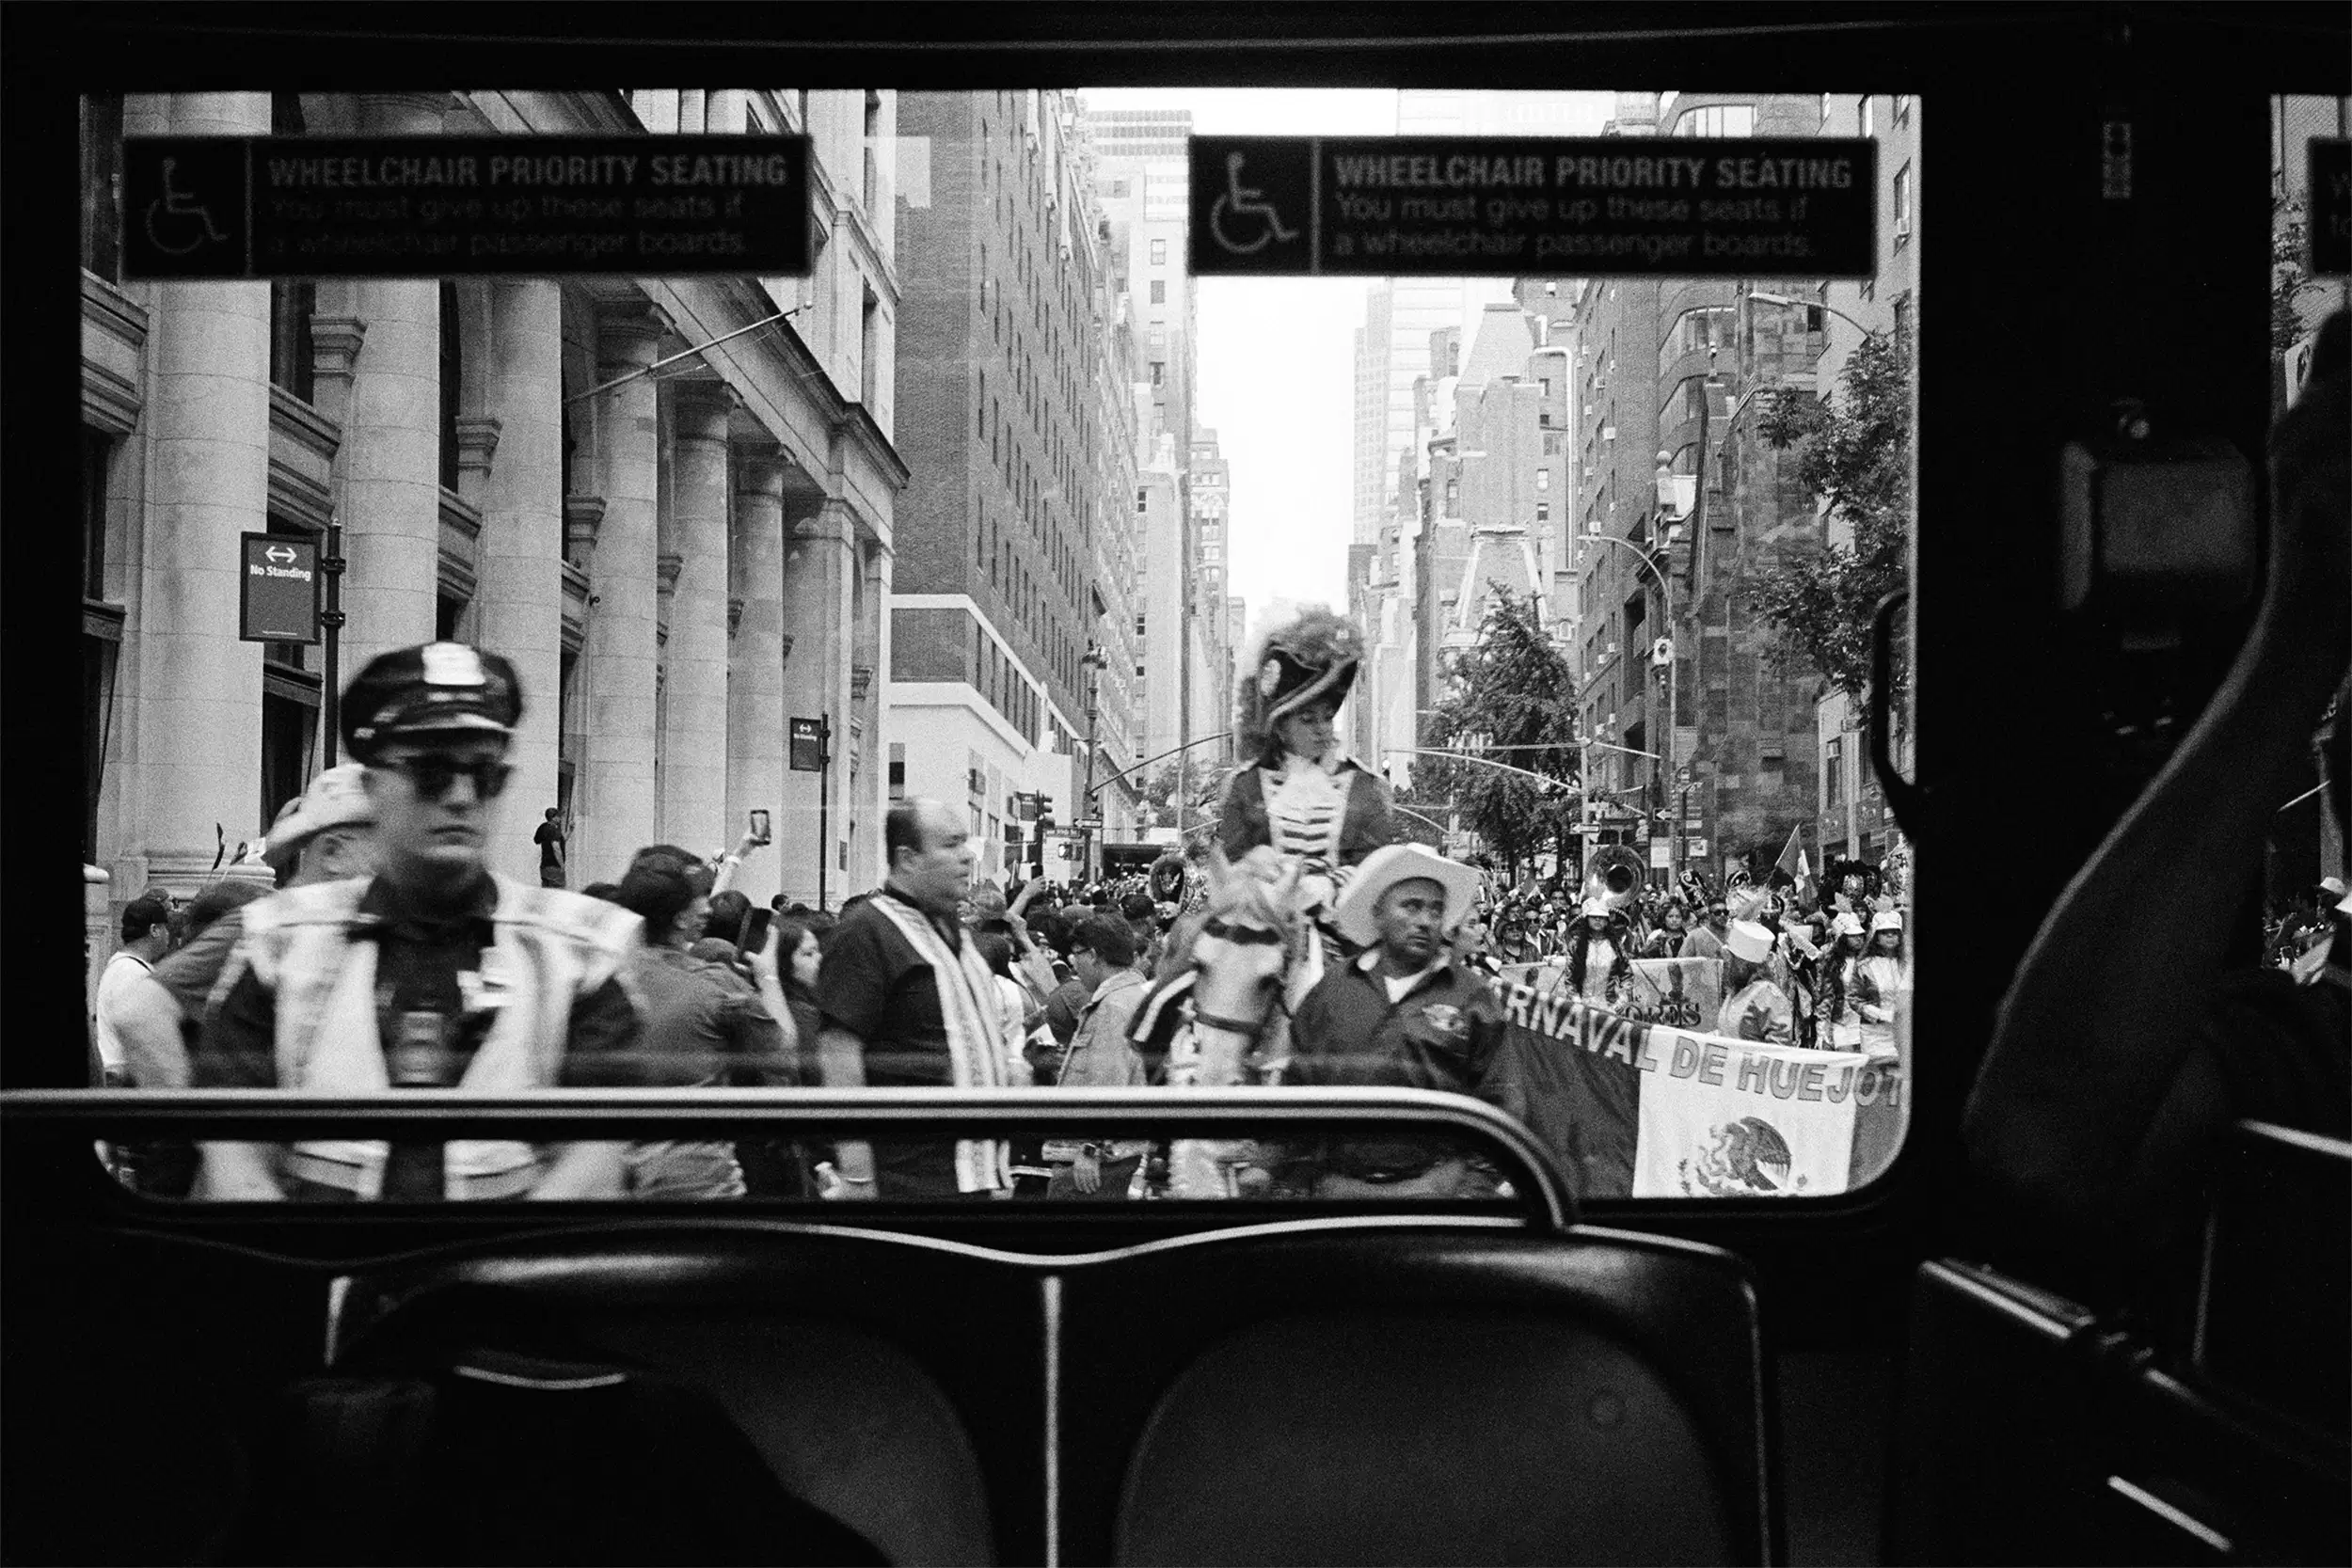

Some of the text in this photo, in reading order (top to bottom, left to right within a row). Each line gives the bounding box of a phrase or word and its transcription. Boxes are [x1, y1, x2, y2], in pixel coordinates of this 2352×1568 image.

[267, 154, 787, 186] WHEELCHAIR PRIORITY SEATING
[1333, 154, 1851, 188] WHEELCHAIR PRIORITY SEATING
[270, 191, 744, 226] You must give up these seats if
[1334, 193, 1808, 225] You must give up these seats if
[298, 232, 458, 254] wheelchair
[470, 232, 630, 260] passenger
[1334, 237, 1353, 255] a
[1362, 231, 1525, 256] wheelchair
[1535, 234, 1692, 263] passenger
[249, 564, 311, 581] No Standing
[1670, 1037, 1728, 1086] DE
